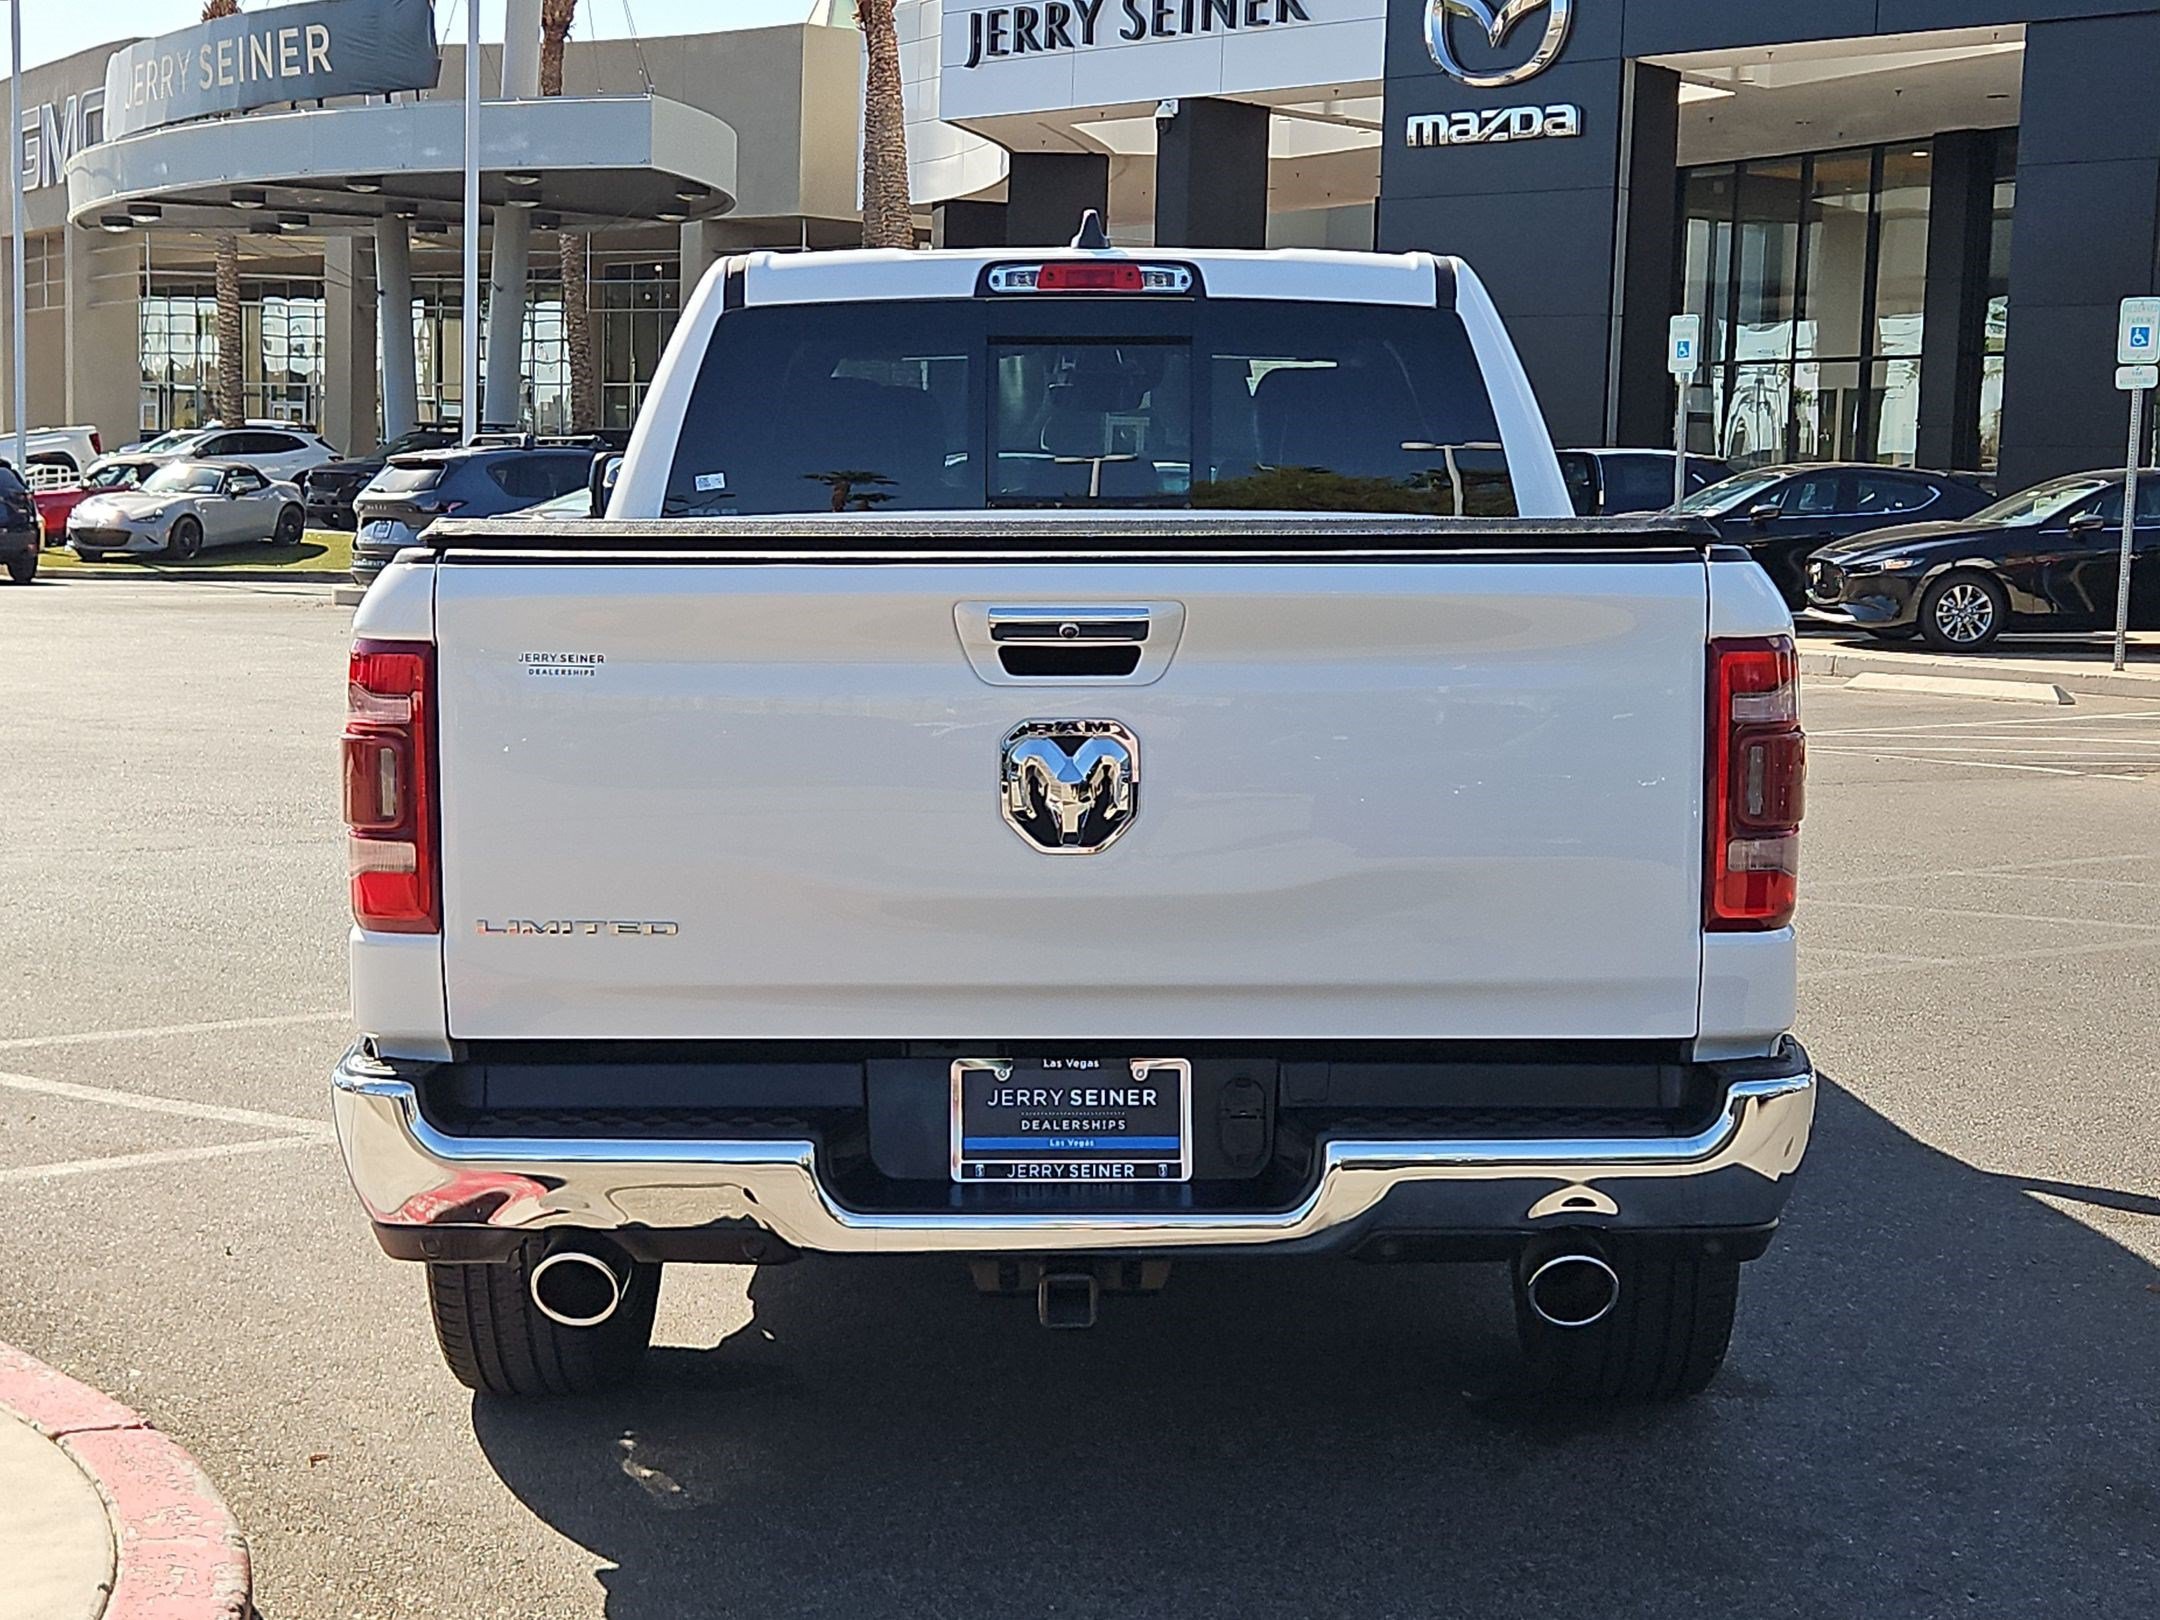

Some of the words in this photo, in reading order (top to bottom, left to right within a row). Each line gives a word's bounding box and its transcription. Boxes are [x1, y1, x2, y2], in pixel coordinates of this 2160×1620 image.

[964, 0, 1102, 68] JERRY
[125, 49, 191, 111] JERRY
[199, 24, 333, 91] SEINER
[518, 653, 557, 663] JERRY
[560, 654, 605, 664] SEINER
[528, 668, 595, 676] DEALERSHIPS
[1028, 721, 1111, 734] RAM
[476, 919, 678, 935] LIMITED
[1043, 1059, 1062, 1069] Las
[1065, 1059, 1100, 1070] Vegas
[987, 1089, 1063, 1107] JERRY
[1069, 1089, 1158, 1106] SEINER
[1021, 1120, 1126, 1130] DEALERSHIPS
[1049, 1138, 1065, 1147] Las
[1067, 1138, 1095, 1149] Vegas
[1007, 1164, 1065, 1178] JERRY
[1069, 1164, 1135, 1178] SEINER
